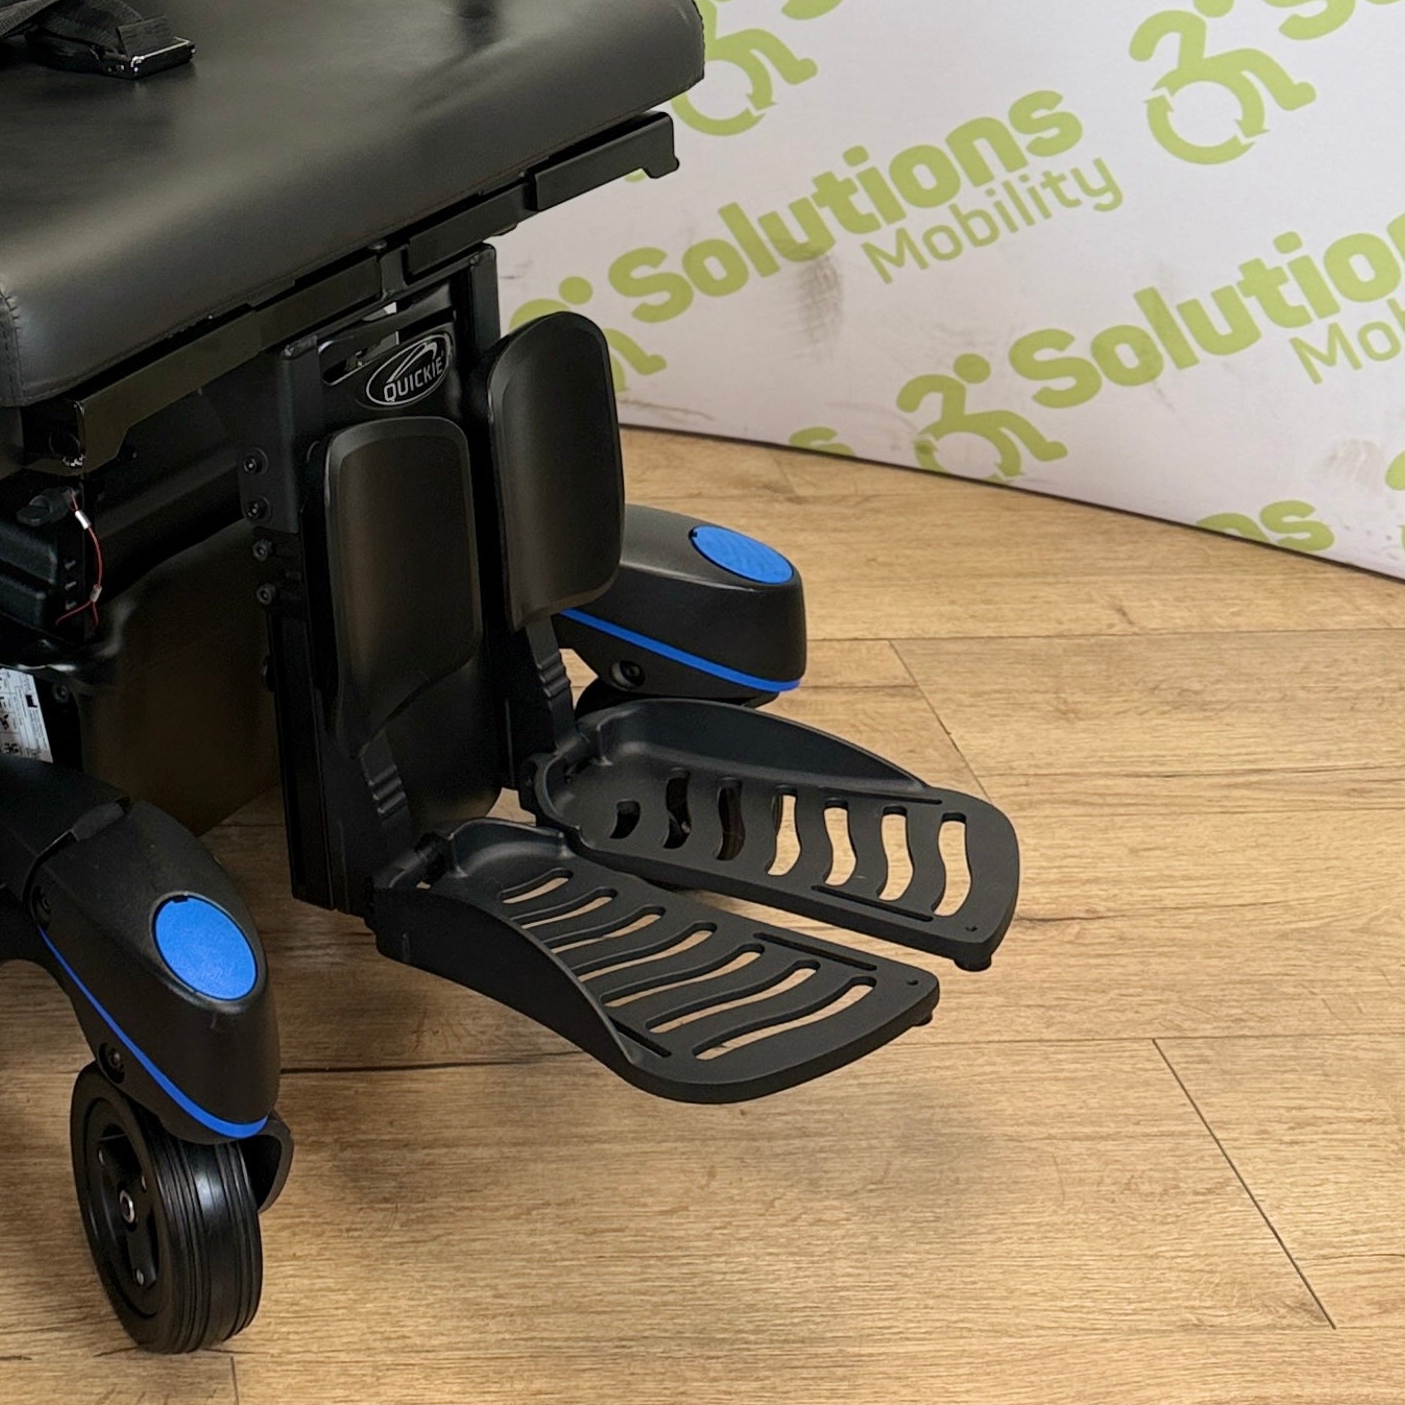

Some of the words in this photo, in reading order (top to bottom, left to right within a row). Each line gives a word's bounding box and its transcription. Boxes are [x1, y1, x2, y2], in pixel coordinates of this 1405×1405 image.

[608, 90, 1083, 323] Solutions
[862, 157, 1123, 285] Mobility
[383, 356, 444, 402] QUICKIE
[1008, 213, 1405, 409] Solutio
